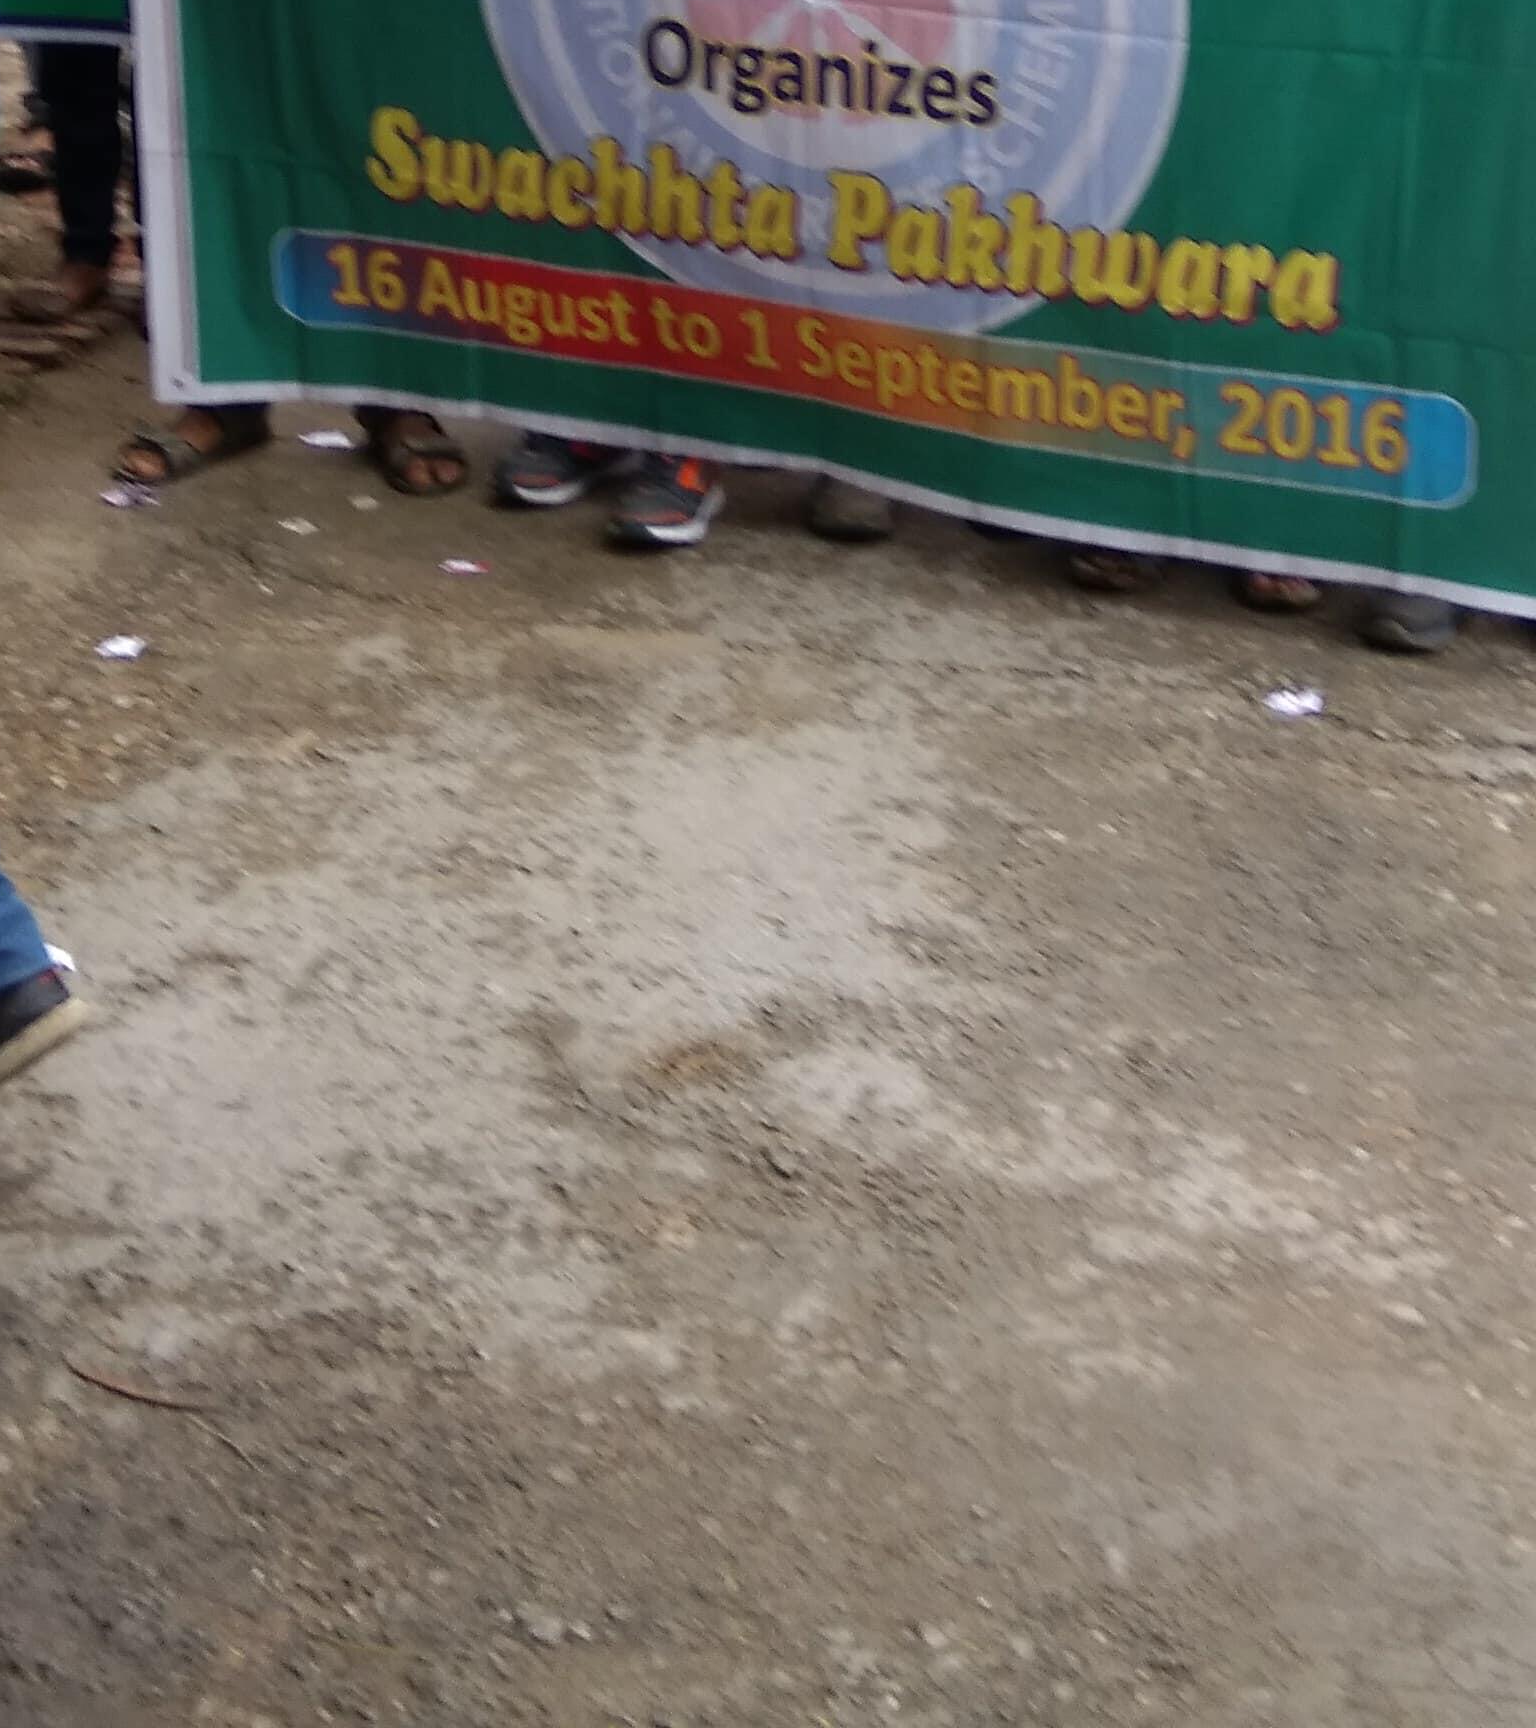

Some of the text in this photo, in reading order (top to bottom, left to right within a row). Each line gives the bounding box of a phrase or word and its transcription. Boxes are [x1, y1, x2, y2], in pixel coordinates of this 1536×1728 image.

[644, 18, 998, 126] Organizes
[366, 105, 802, 262] Swachhta
[825, 169, 1344, 332] Pakhwara
[326, 242, 1410, 474] 16 August to 1 September, 2016
